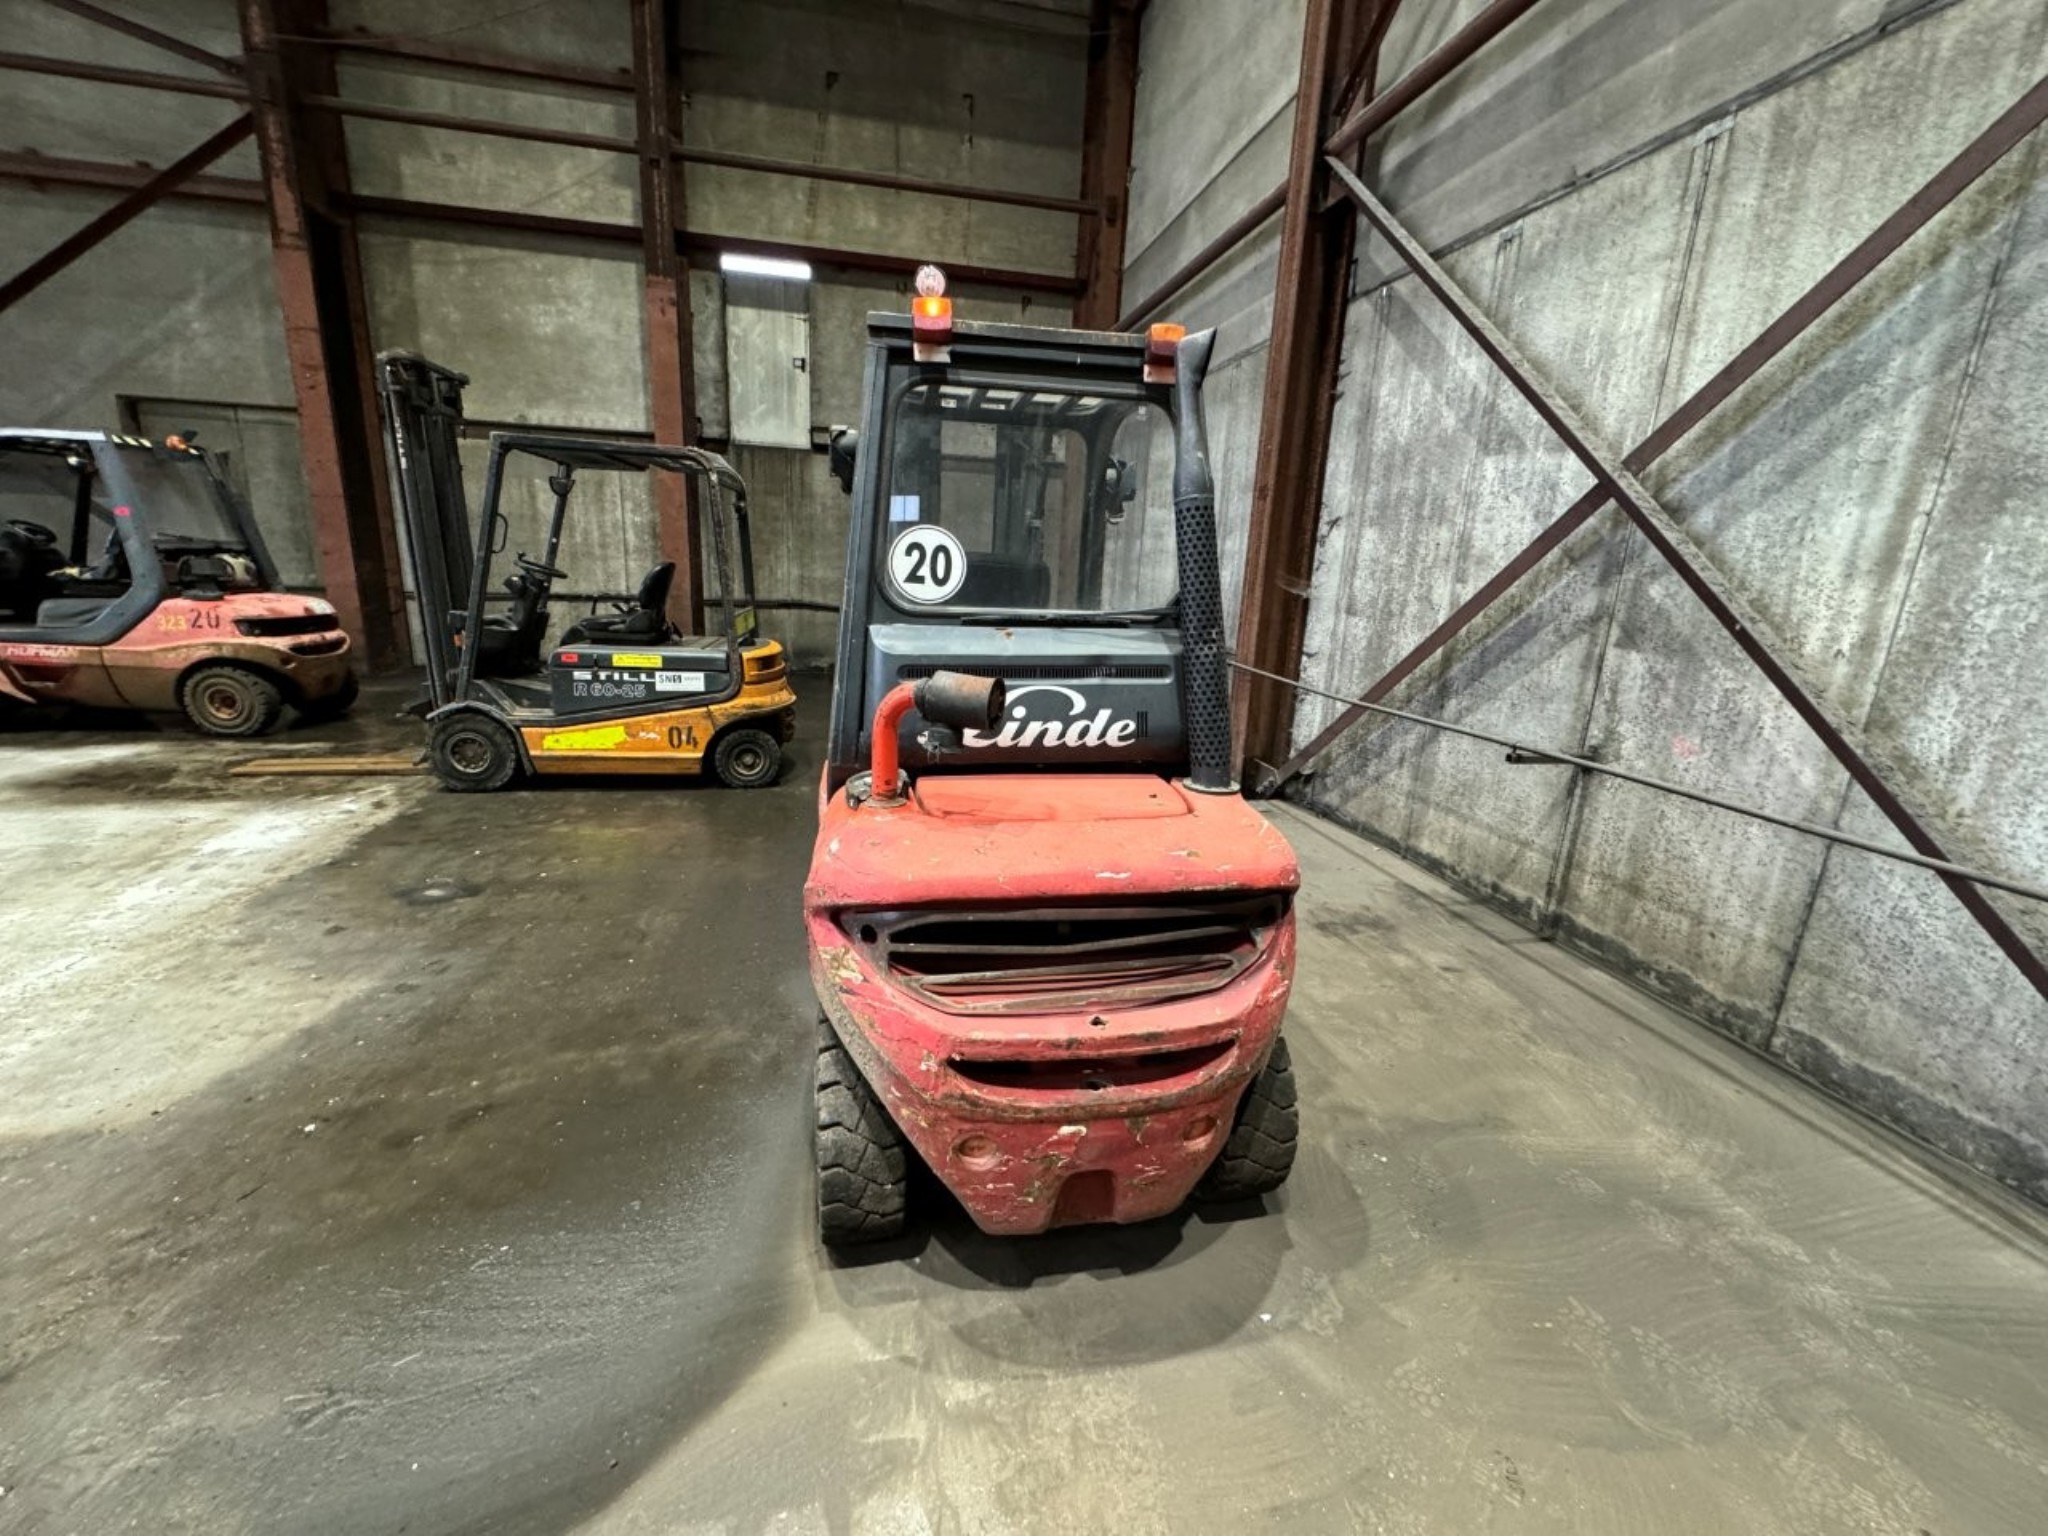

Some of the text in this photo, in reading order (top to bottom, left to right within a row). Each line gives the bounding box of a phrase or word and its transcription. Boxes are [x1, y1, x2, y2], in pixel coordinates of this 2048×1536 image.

[903, 542, 953, 588] 20
[189, 607, 220, 630] 20
[572, 671, 656, 683] STILL
[573, 682, 588, 697] R
[667, 725, 699, 749] 04
